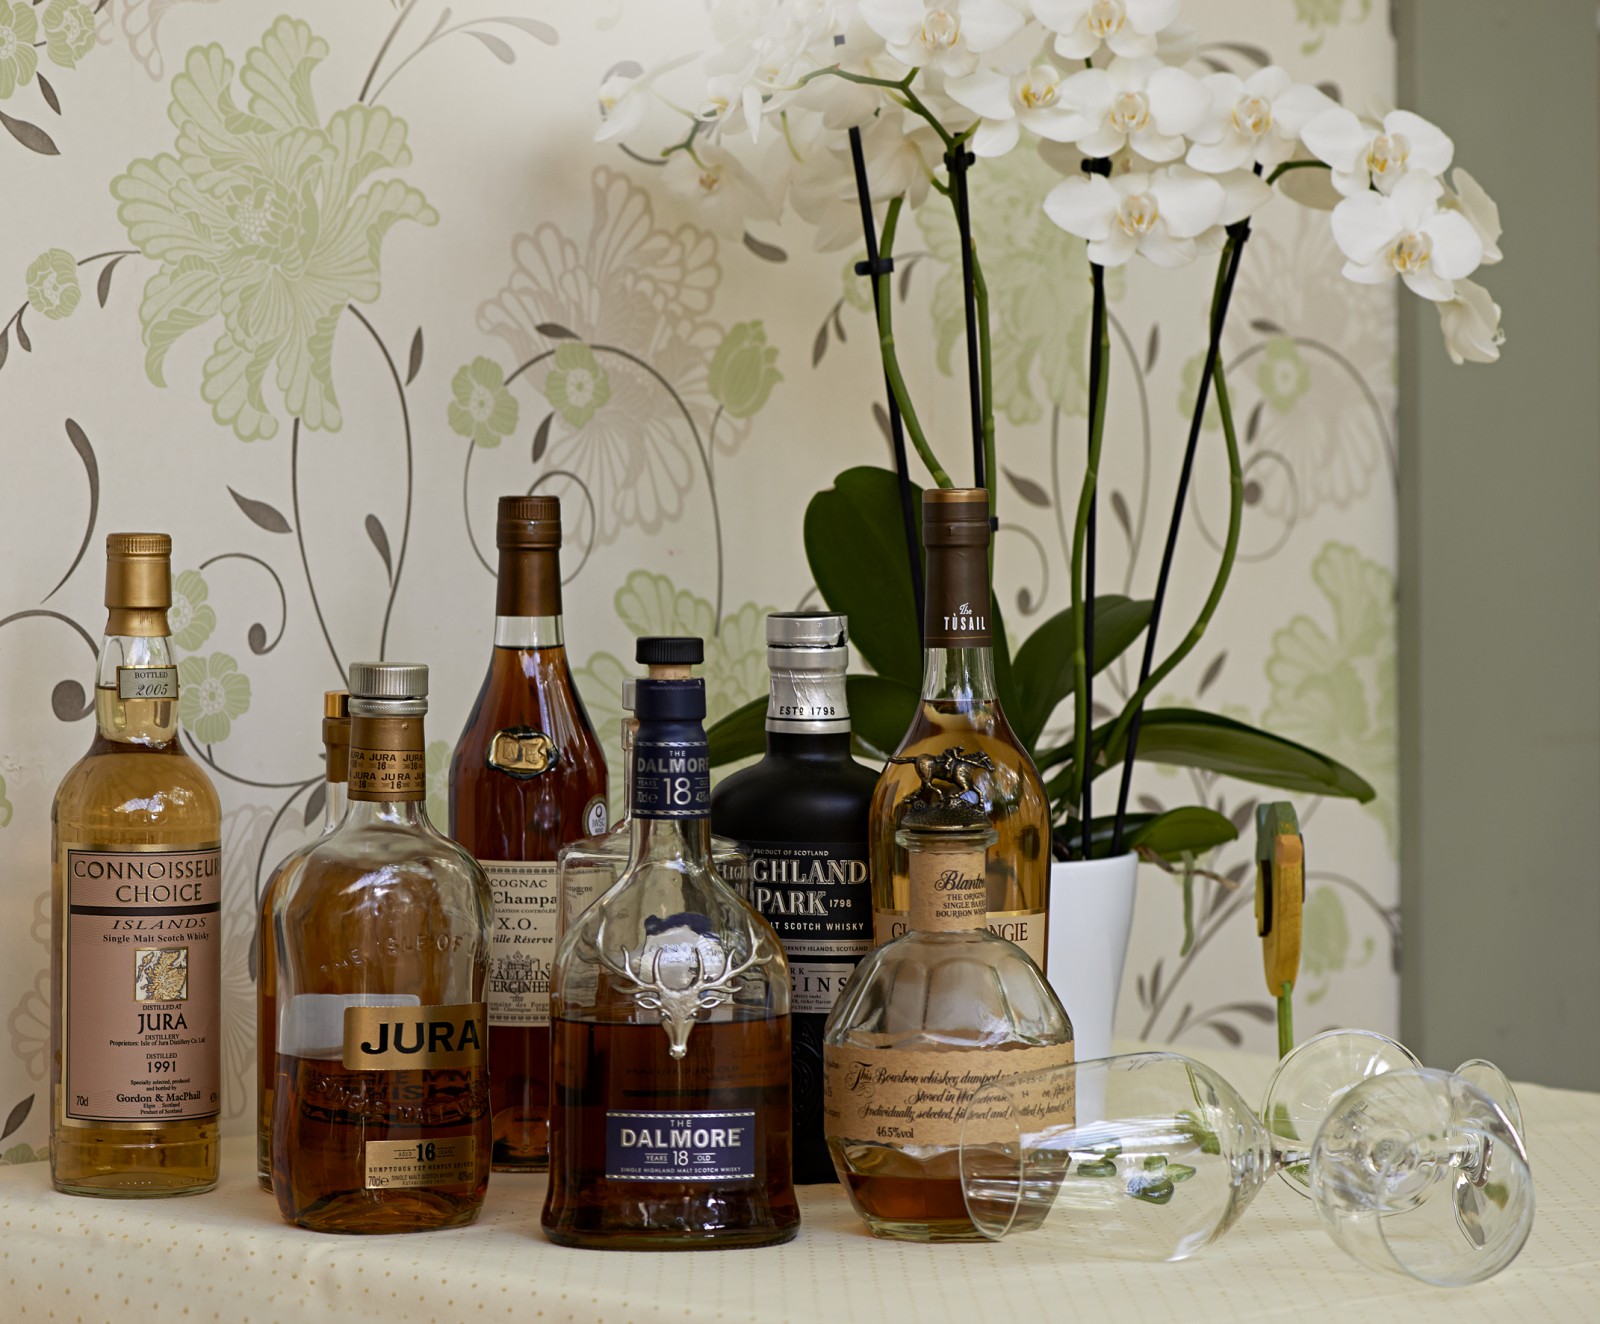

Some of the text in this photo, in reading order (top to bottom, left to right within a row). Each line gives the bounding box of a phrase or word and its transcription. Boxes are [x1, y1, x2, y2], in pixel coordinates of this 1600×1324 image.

[959, 602, 972, 615] The
[944, 612, 986, 631] TÙSAIL
[135, 684, 168, 696] 2005
[812, 706, 836, 716] 1798
[351, 752, 423, 762] URA JURA JURA
[377, 762, 387, 770] 16
[410, 762, 418, 770] 16
[353, 772, 425, 781] JURA JURA JU
[390, 781, 402, 790] 16
[663, 777, 692, 805] 18
[752, 858, 868, 885] GHLAND
[490, 878, 548, 888] COGNAC
[116, 883, 203, 902] CHOICE
[494, 891, 557, 908] Champa
[755, 886, 852, 916] PARK 1798
[942, 902, 970, 910] SINGLE
[935, 910, 972, 918] BOURBON
[112, 917, 207, 930] ISLANDS
[498, 918, 538, 930] X.O.
[784, 922, 821, 930] SCOTCH
[826, 922, 864, 931] WHISKY
[102, 932, 209, 944] Single Malt Scotch Whisky
[514, 934, 554, 944] Réserve
[137, 1012, 188, 1034] JURA
[170, 1038, 190, 1046] Distillery
[360, 1020, 480, 1055] JURA
[146, 1052, 178, 1060] DISTILLED
[147, 1060, 176, 1073] 1991
[845, 1061, 873, 1090] This
[875, 1067, 919, 1084] Bourbon
[920, 1070, 959, 1088] whiskey
[960, 1070, 1002, 1089] dumped
[116, 1094, 152, 1102] Gordon
[155, 1094, 164, 1102] &
[166, 1091, 200, 1102] MacPhail
[904, 1088, 945, 1104] Stored
[946, 1090, 956, 1104] in
[858, 1102, 915, 1123] Individually
[670, 1120, 692, 1128] THE
[620, 1128, 742, 1148] DALMORE
[416, 1142, 436, 1162] 16
[672, 1150, 689, 1166] 18
